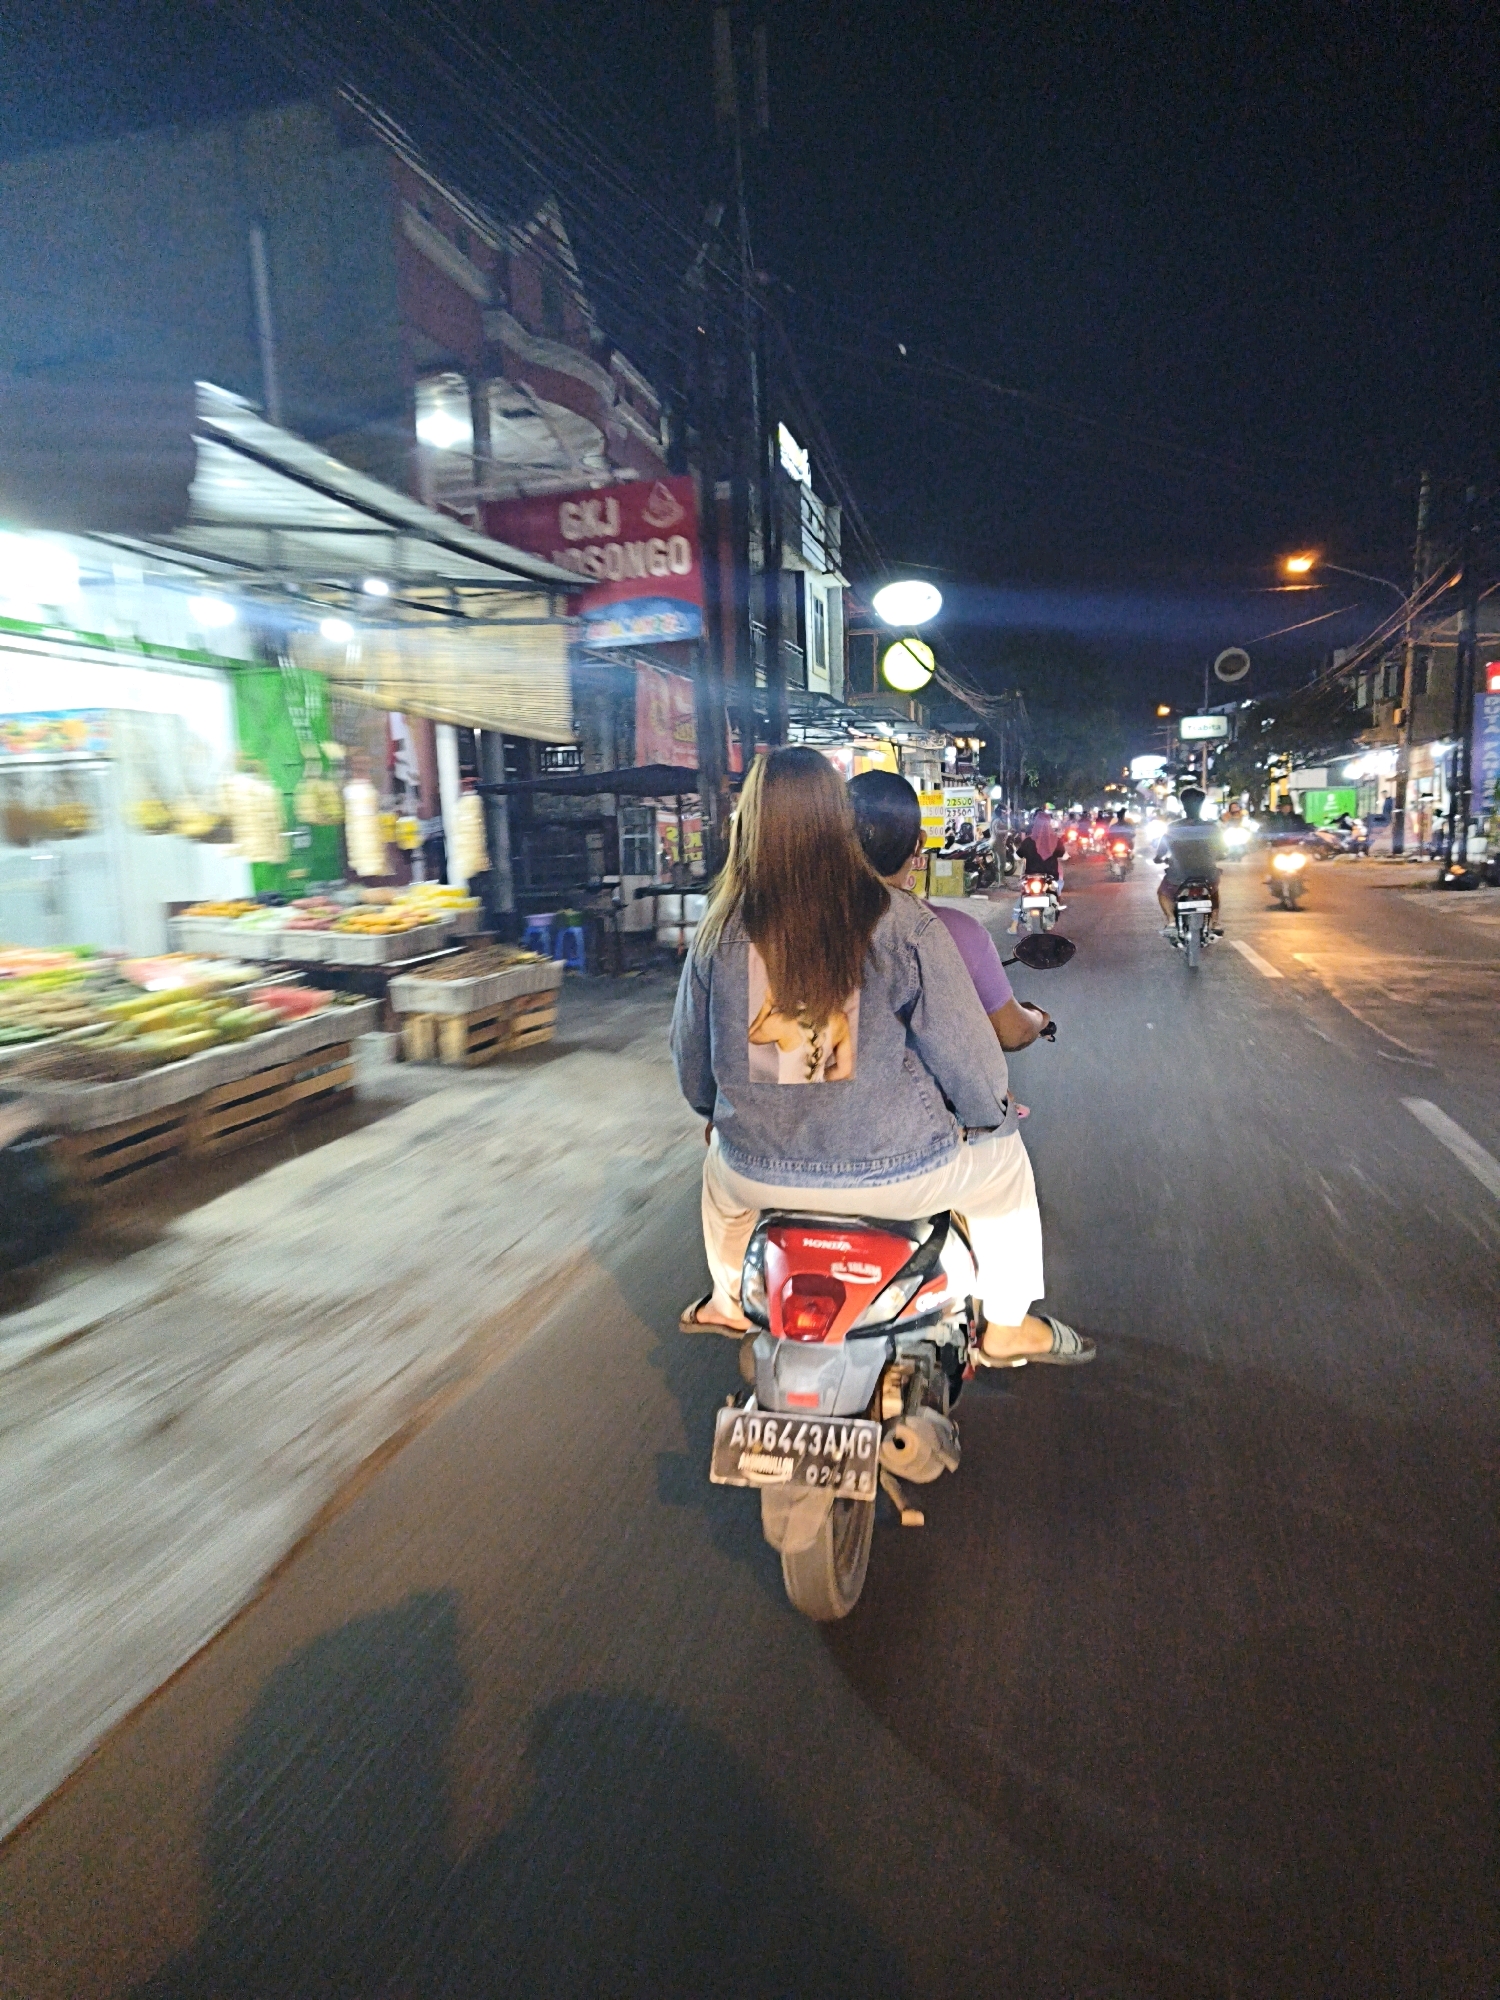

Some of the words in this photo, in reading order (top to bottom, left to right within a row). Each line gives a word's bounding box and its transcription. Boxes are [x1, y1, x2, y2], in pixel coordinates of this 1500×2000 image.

[946, 797, 973, 806] 22500
[946, 808, 972, 818] 23500
[802, 1238, 852, 1251] HONDA
